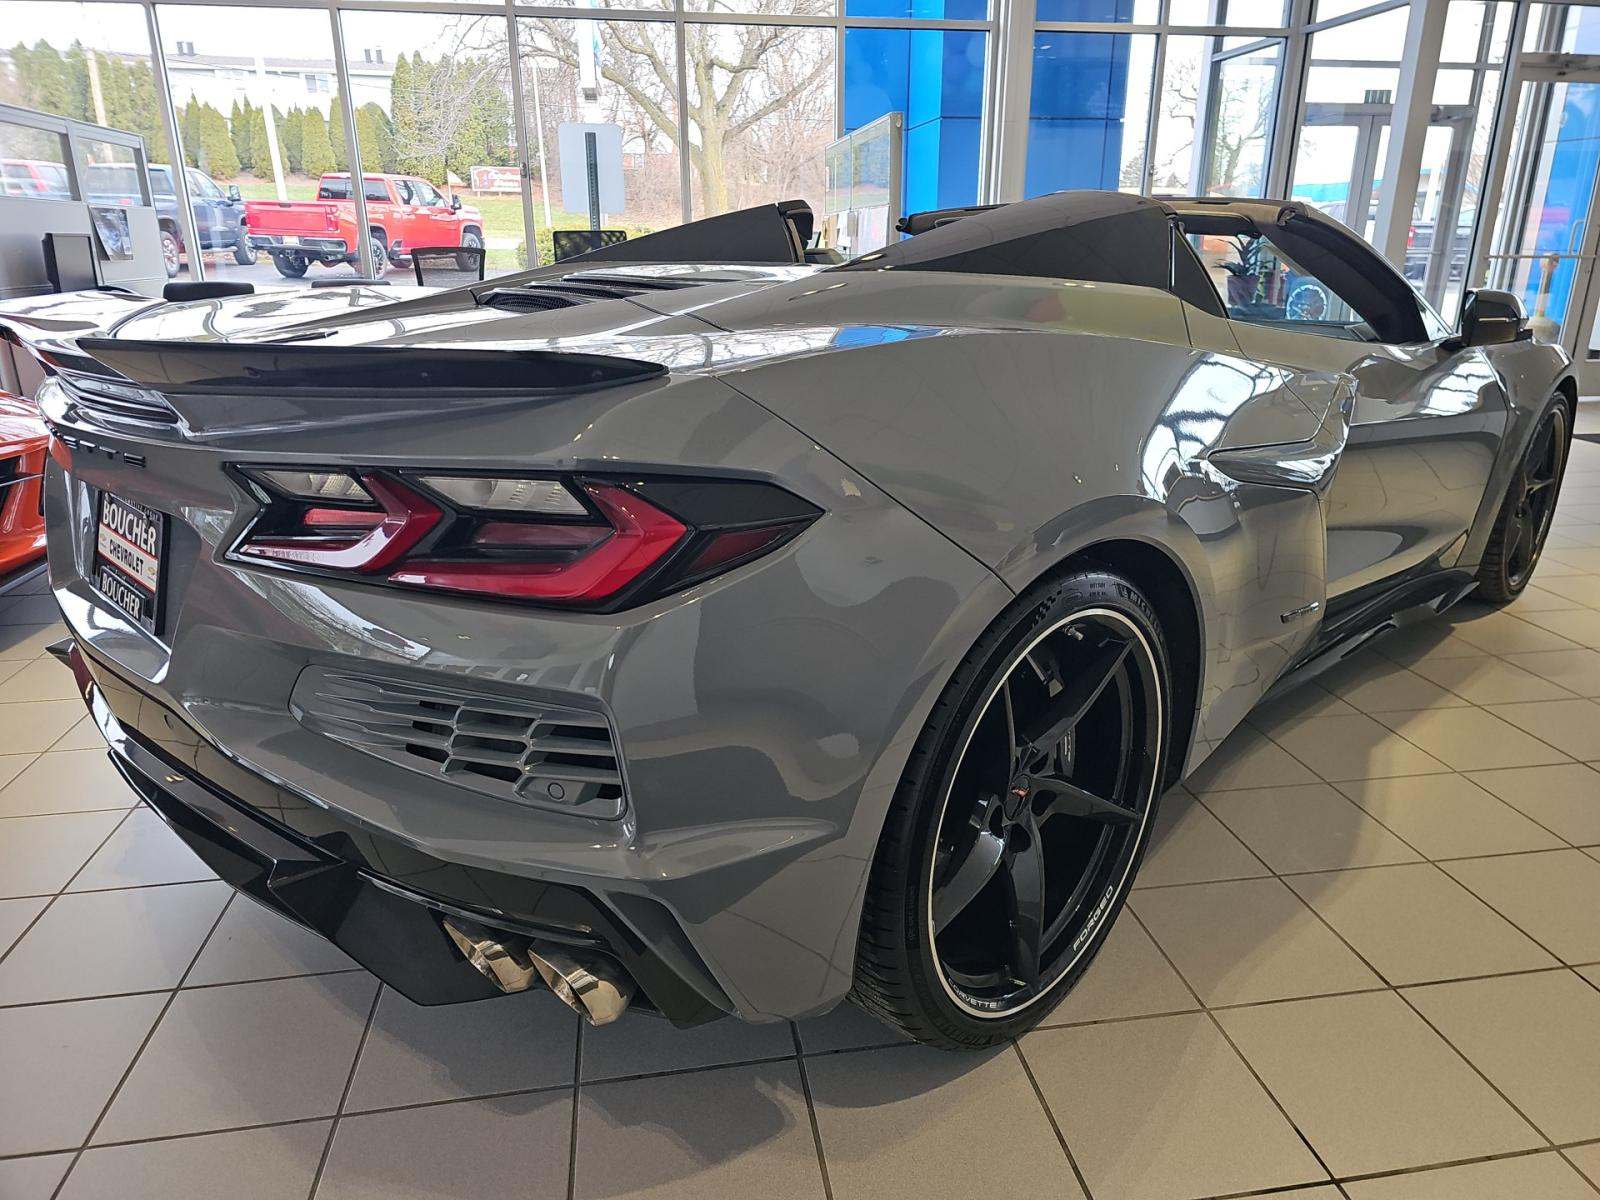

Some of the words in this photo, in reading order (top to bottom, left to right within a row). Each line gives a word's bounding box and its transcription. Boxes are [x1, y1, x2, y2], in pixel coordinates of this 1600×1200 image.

[103, 499, 157, 556] BOUCHER
[109, 539, 144, 576] CHEVROLET
[101, 572, 140, 619] BOUCHER
[1073, 885, 1113, 951] FORGED
[948, 977, 998, 1009] CORVETTE
